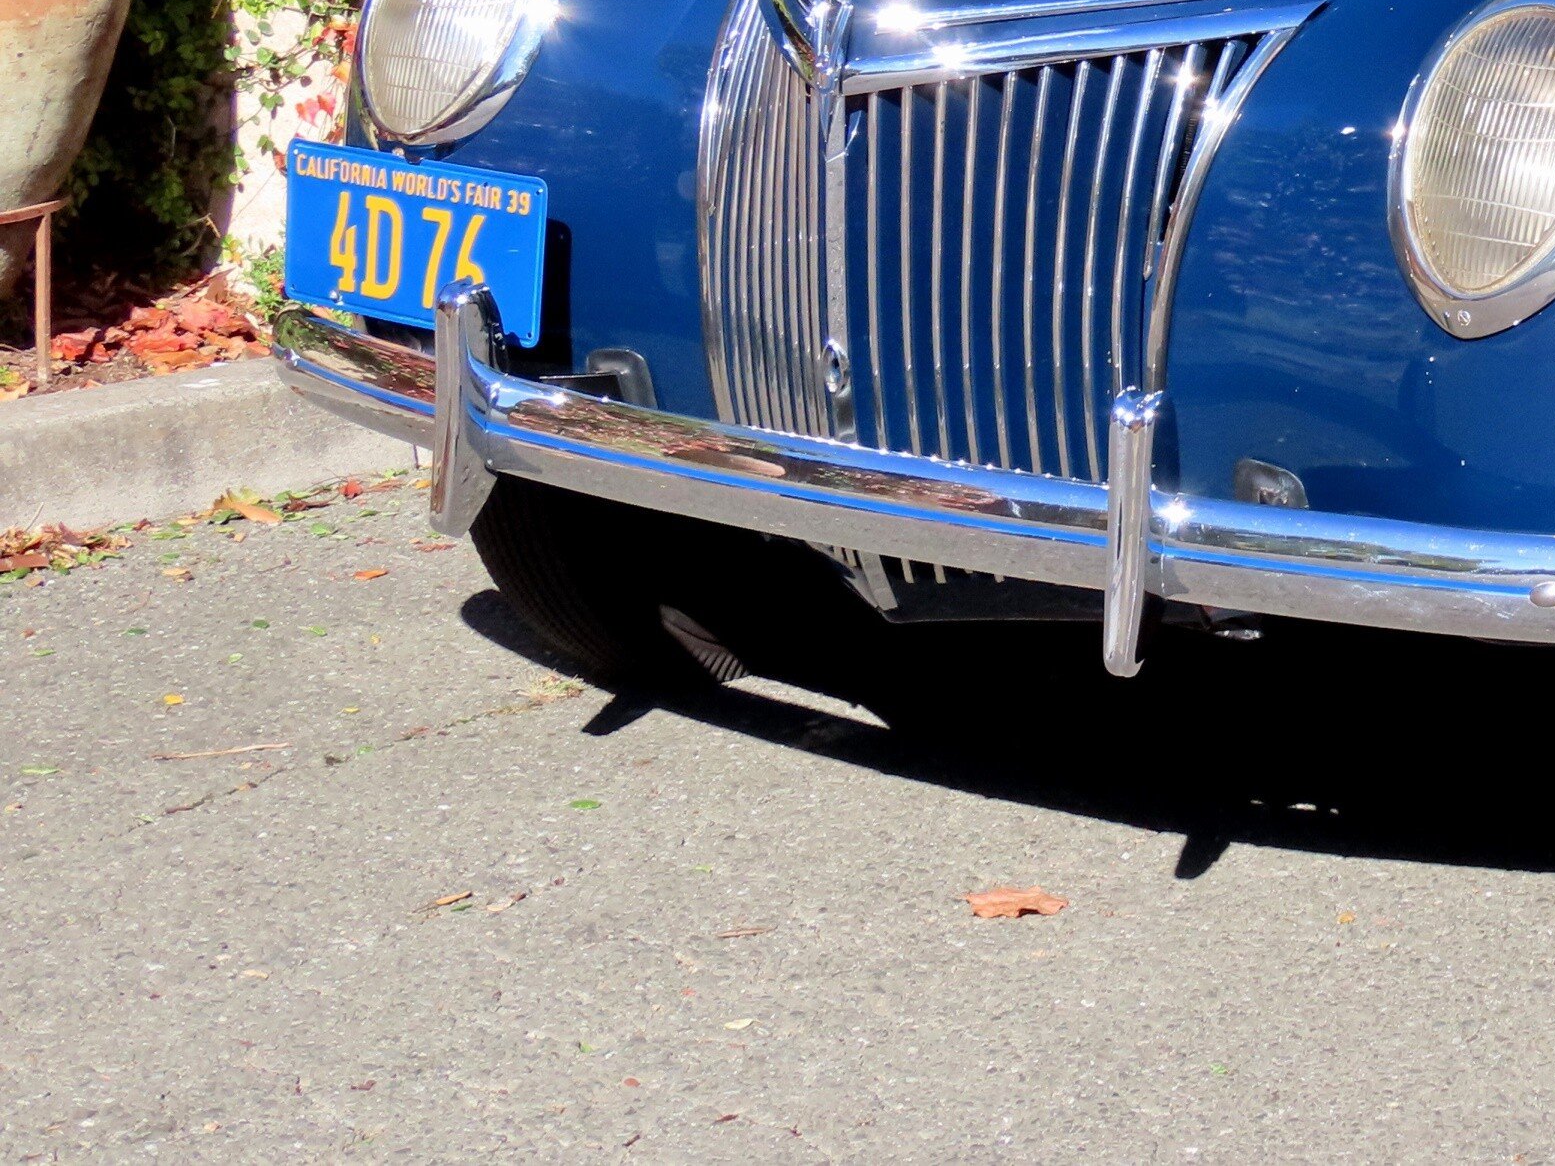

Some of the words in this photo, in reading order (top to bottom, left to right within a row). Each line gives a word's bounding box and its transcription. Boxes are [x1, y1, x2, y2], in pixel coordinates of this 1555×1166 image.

[296, 153, 388, 189] CALIFORNIA
[391, 170, 462, 204] WORLD'S
[464, 183, 502, 211] FAIR
[505, 189, 532, 216] 39
[329, 190, 402, 299] 4D
